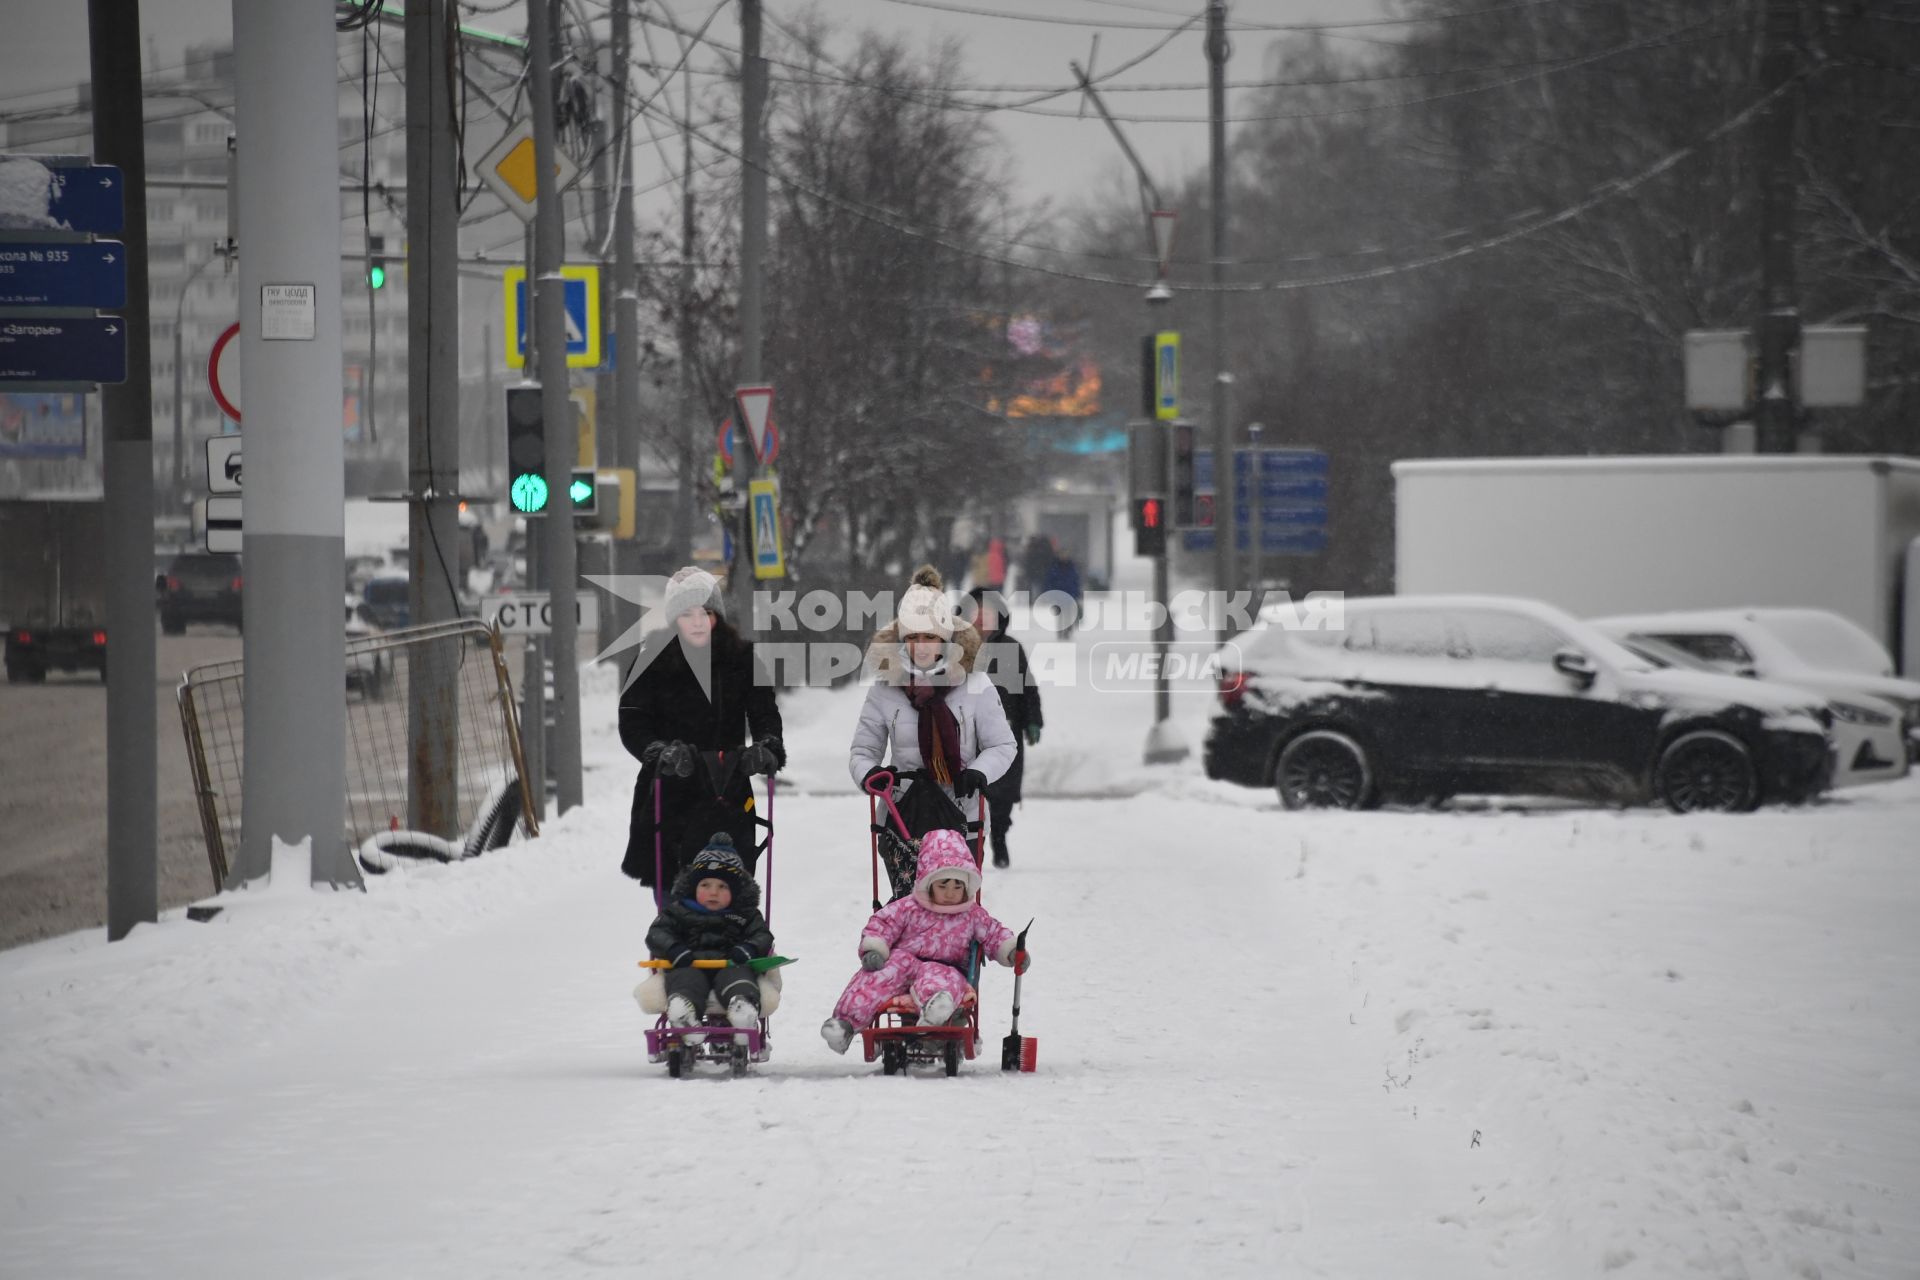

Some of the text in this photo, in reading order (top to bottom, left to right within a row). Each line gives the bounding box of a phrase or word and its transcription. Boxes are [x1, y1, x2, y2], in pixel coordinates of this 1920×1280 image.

[30, 251, 43, 262] №
[46, 250, 69, 262] 935
[3, 324, 63, 338] «Загорье»
[498, 602, 581, 628] СТО
